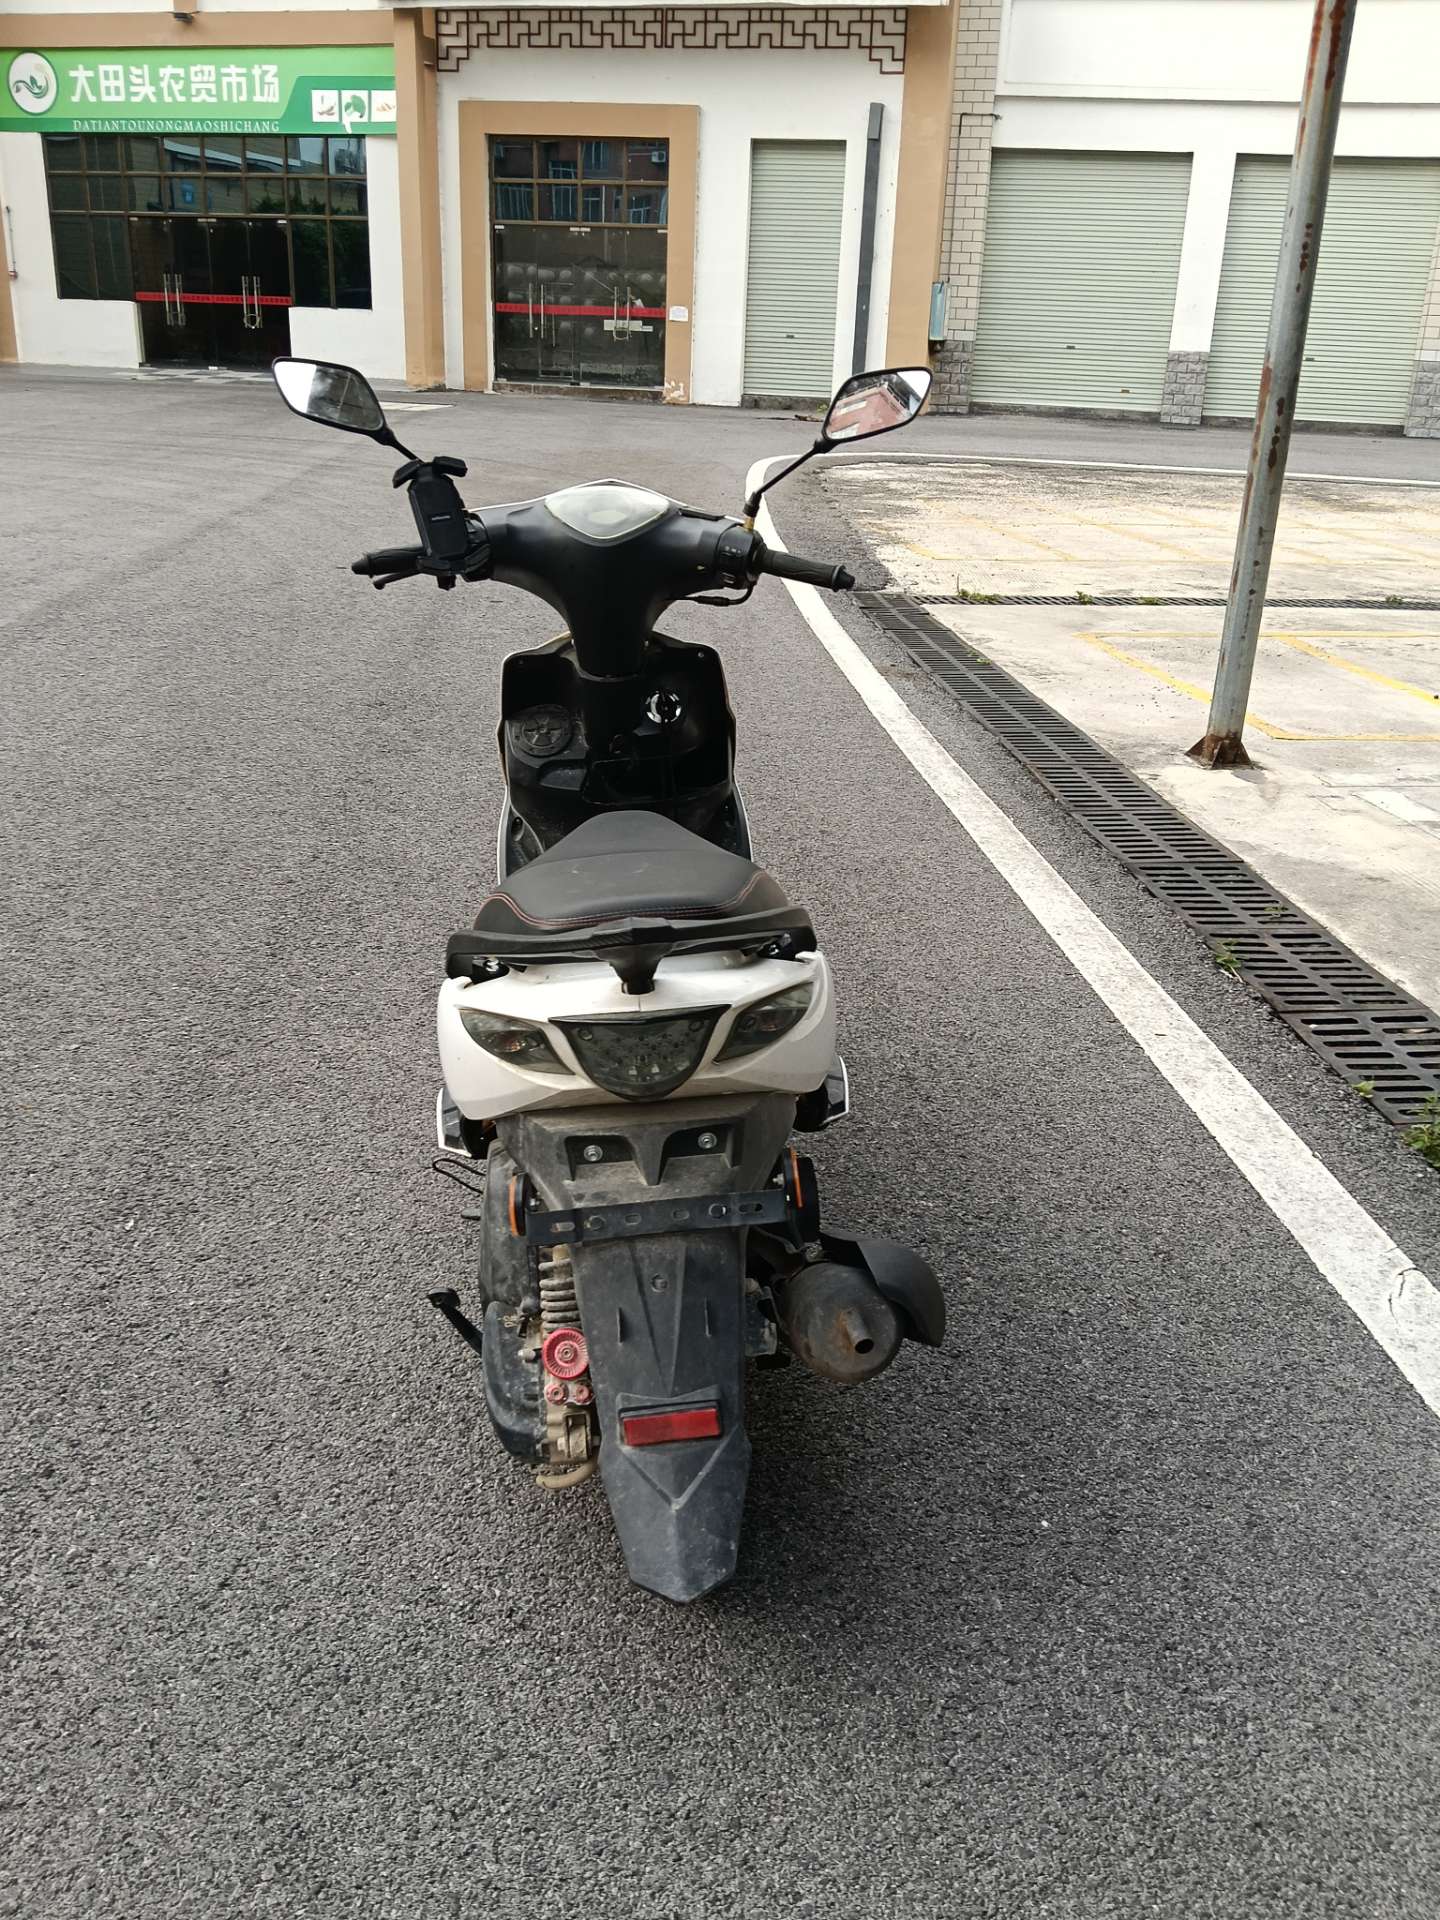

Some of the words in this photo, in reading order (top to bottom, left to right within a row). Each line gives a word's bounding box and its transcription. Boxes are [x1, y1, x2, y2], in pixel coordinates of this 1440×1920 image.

[69, 64, 280, 103] 大田头农贸市场
[73, 119, 280, 132] DATIANTOUNONGMAOSHICHANG
